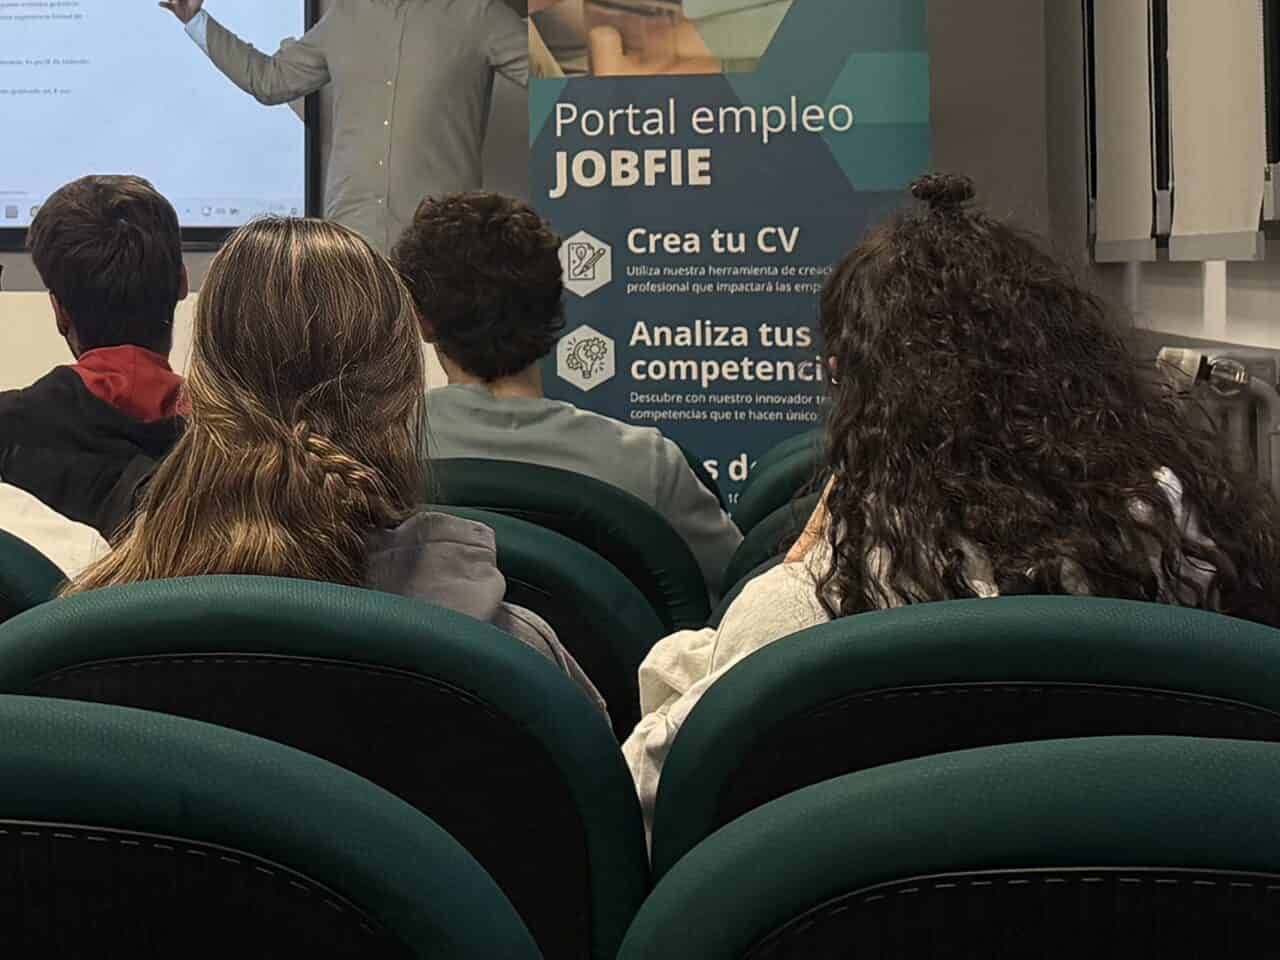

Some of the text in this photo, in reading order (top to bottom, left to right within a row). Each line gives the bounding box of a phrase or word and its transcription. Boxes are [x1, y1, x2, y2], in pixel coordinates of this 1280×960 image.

[555, 95, 854, 144] Portal empleo
[548, 148, 712, 199] JOBFIE
[626, 226, 800, 254] Crea tu CV
[626, 265, 661, 277] Utiliza
[663, 266, 705, 277] nuestra
[708, 264, 778, 276] herramienta
[780, 264, 796, 276] de
[626, 281, 689, 295] profesional
[692, 283, 714, 295] que
[716, 280, 773, 294] impactará
[775, 280, 792, 293] las
[629, 319, 812, 348] Analiza tus
[630, 392, 682, 404] Descubre
[685, 394, 706, 404] con
[708, 393, 753, 404] nuestro
[755, 392, 812, 405] innovador
[630, 408, 818, 422] competencias que te hacen único
